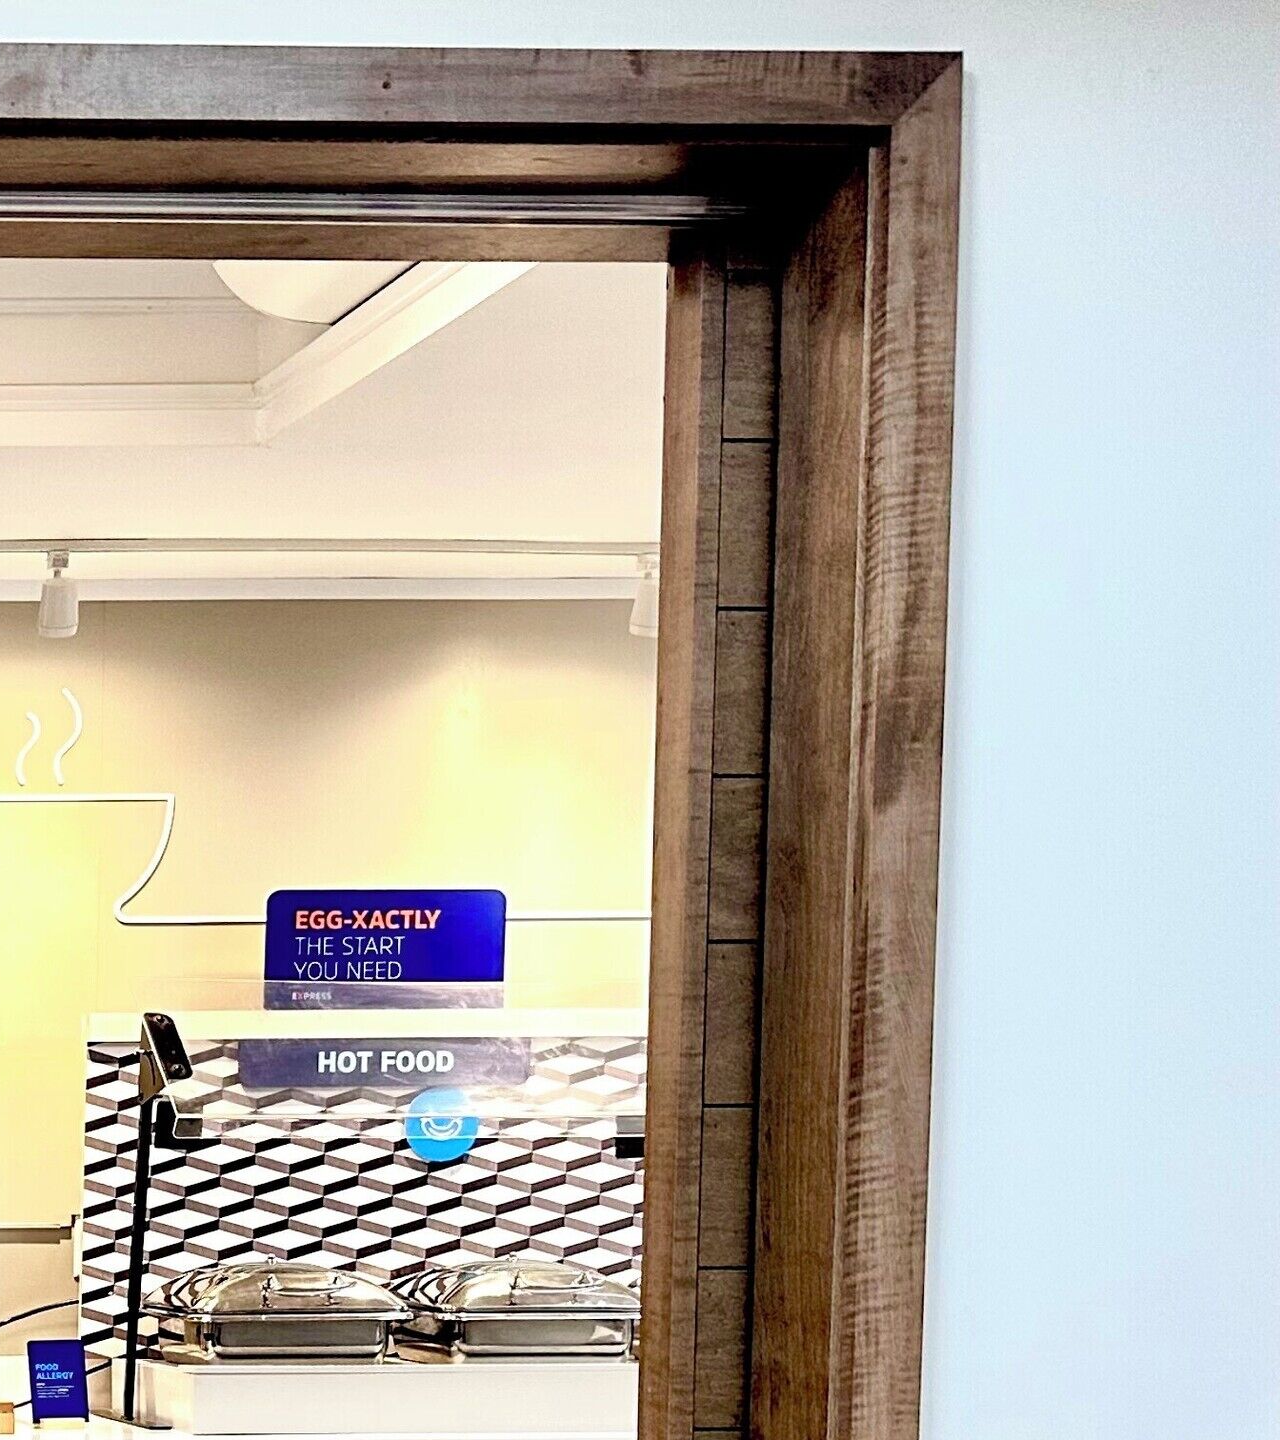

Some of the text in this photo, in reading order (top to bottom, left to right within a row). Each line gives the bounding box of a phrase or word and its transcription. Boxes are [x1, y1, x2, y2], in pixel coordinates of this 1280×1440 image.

[295, 909, 441, 929] EGG-XACTLY
[294, 936, 405, 955] THE START
[293, 961, 402, 980] YOU NEED
[317, 1051, 454, 1073] HOT FOOD
